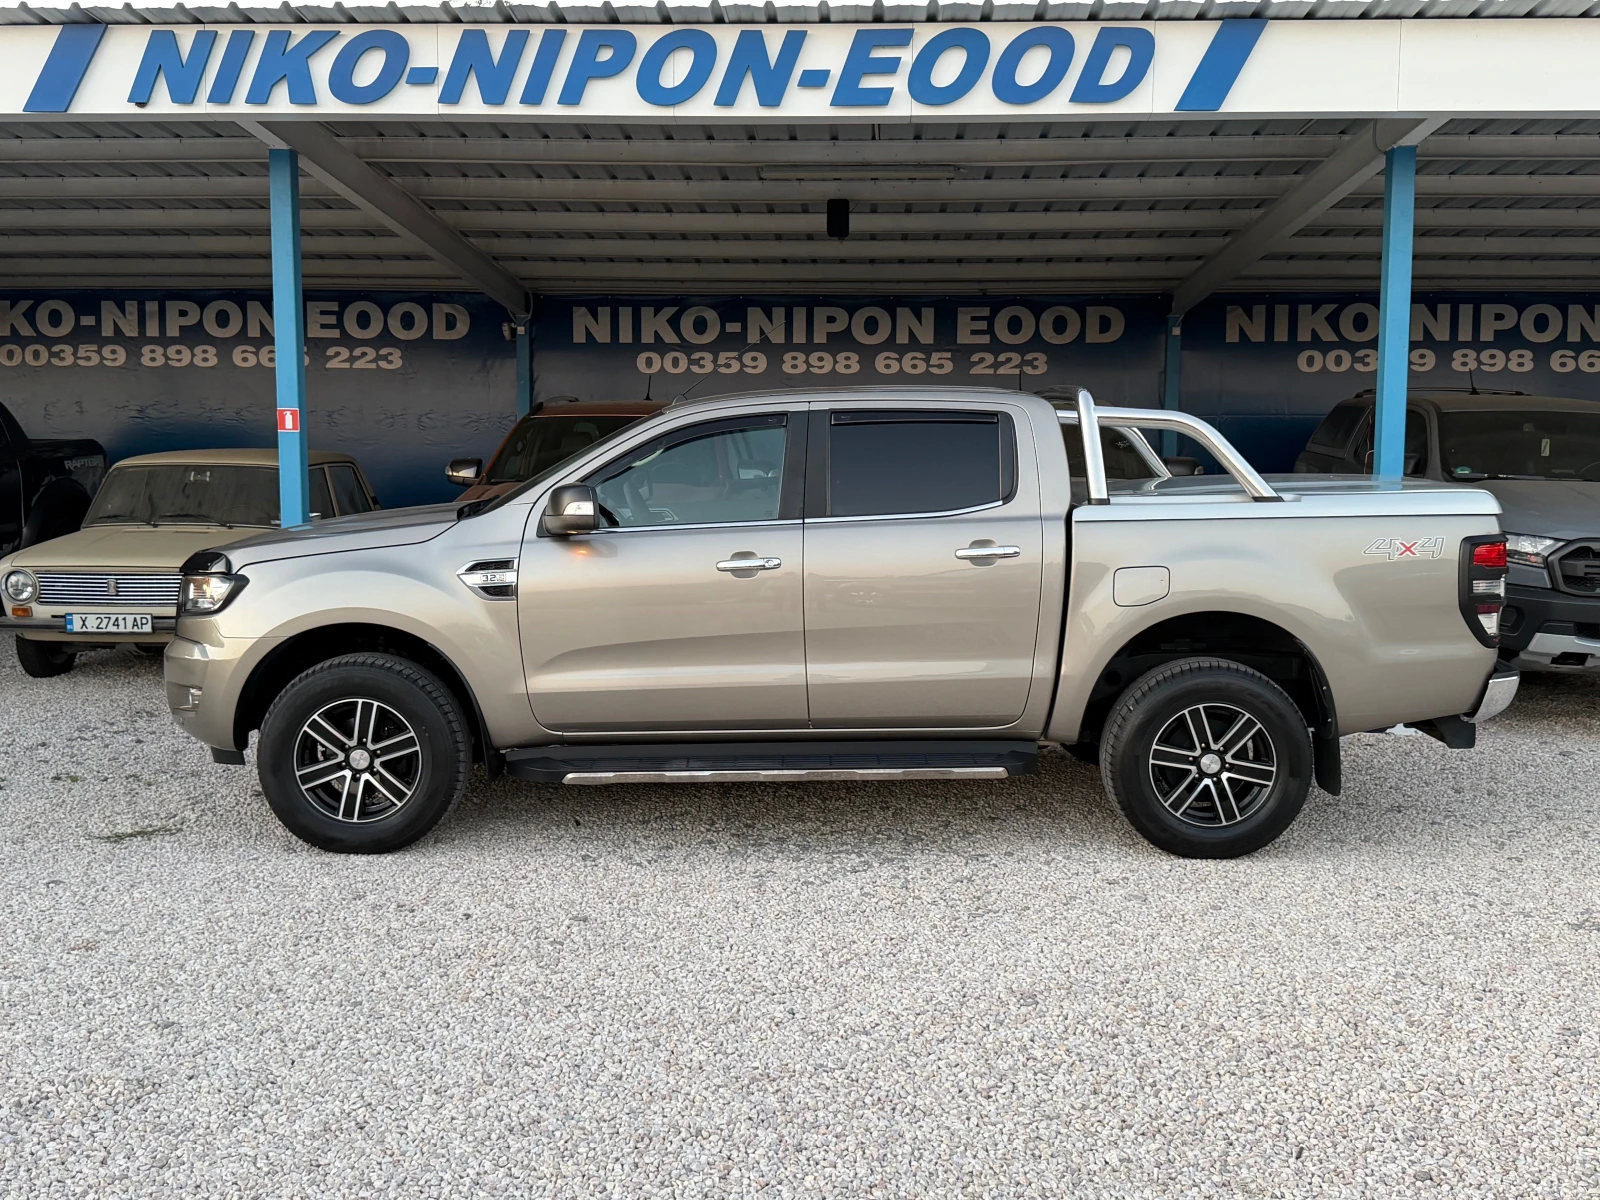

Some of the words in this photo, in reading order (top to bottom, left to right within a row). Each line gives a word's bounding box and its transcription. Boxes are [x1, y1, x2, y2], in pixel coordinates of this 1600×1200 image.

[127, 28, 1155, 107] NIKO-NIPON-EOOD
[306, 301, 471, 341] EOOD
[572, 305, 935, 345] NIKO-NIPON
[957, 305, 1126, 345] EOOD
[1225, 303, 1600, 343] NIKONIPON
[0, 344, 127, 367] 00359
[141, 344, 218, 368] 898
[232, 345, 310, 369] 66
[326, 346, 403, 370] 223
[636, 352, 768, 375] 00359
[781, 352, 861, 375] 898
[874, 352, 954, 375] 665
[969, 352, 1048, 375] 223
[1297, 349, 1436, 373] 0039
[1451, 349, 1534, 373] 898
